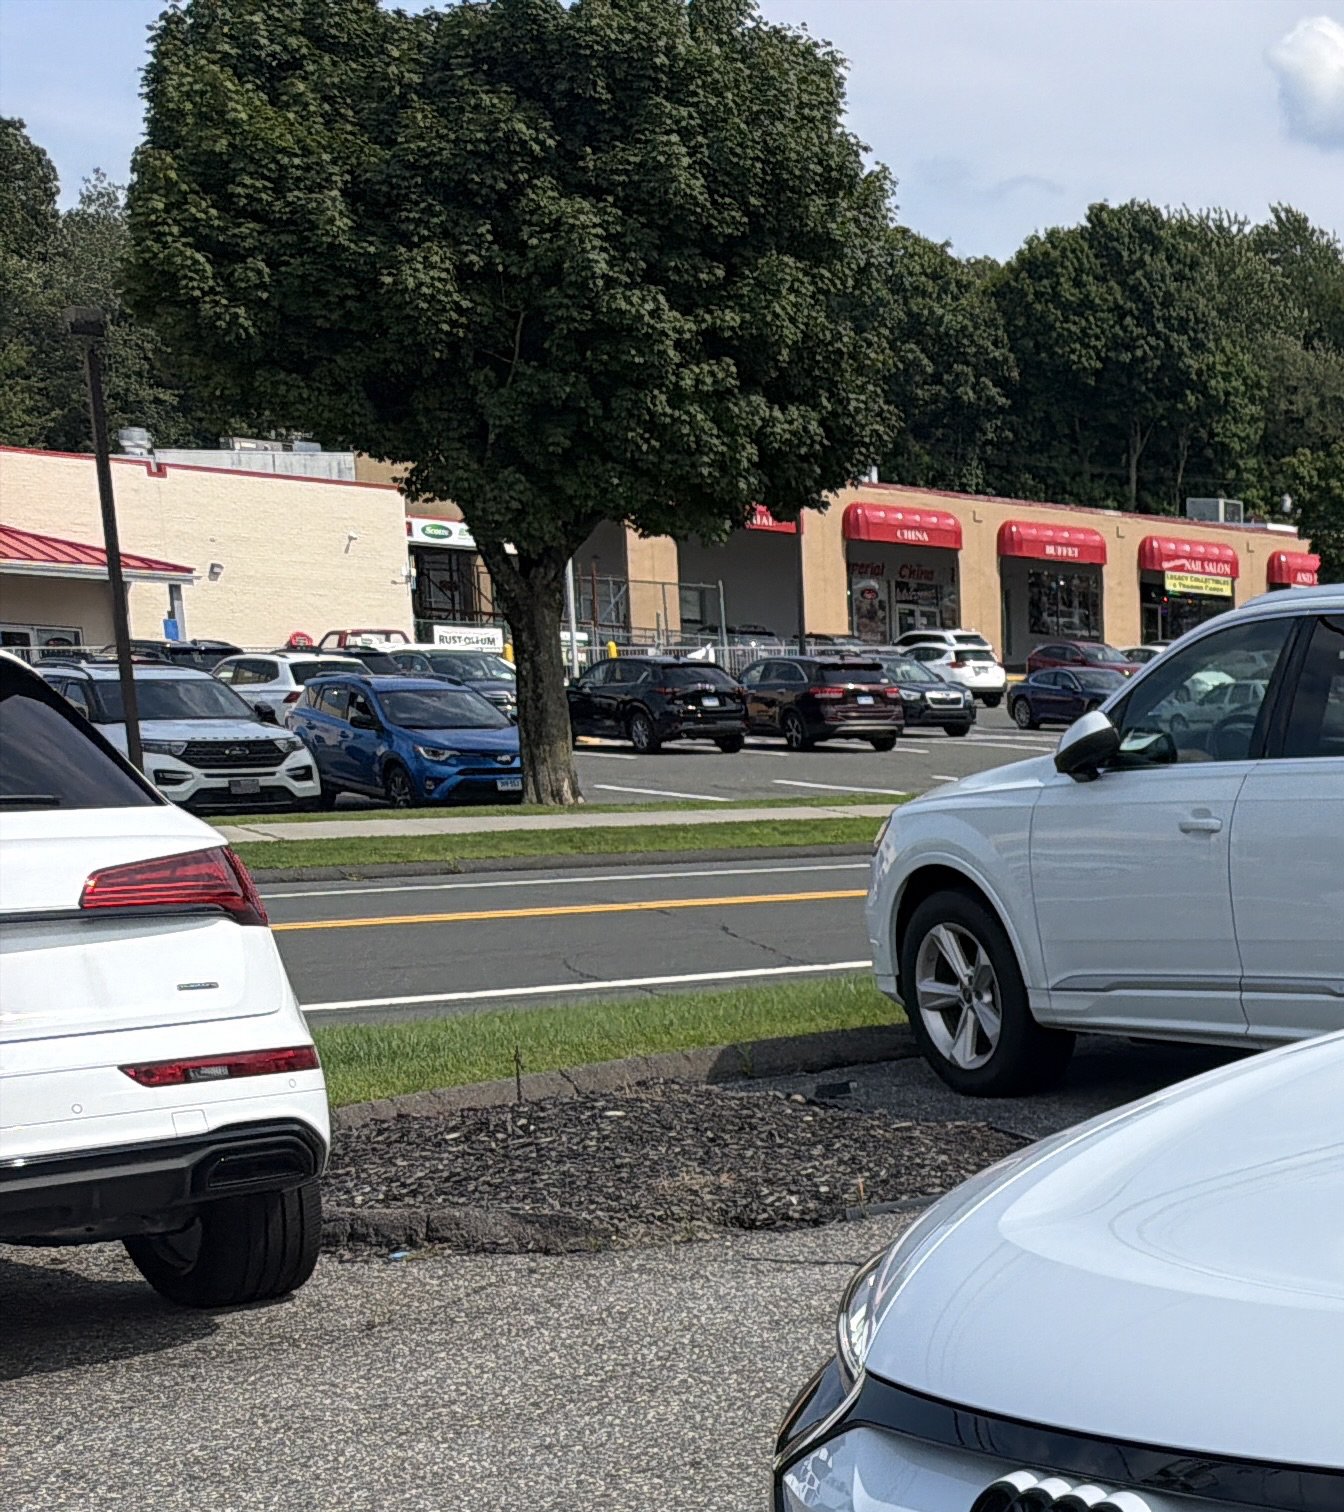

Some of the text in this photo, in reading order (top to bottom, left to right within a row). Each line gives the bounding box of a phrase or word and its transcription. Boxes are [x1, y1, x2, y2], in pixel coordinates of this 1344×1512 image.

[897, 529, 929, 542] CHINA
[850, 562, 885, 577] perial
[1184, 559, 1204, 572] NAIL
[1204, 561, 1231, 575] SALON
